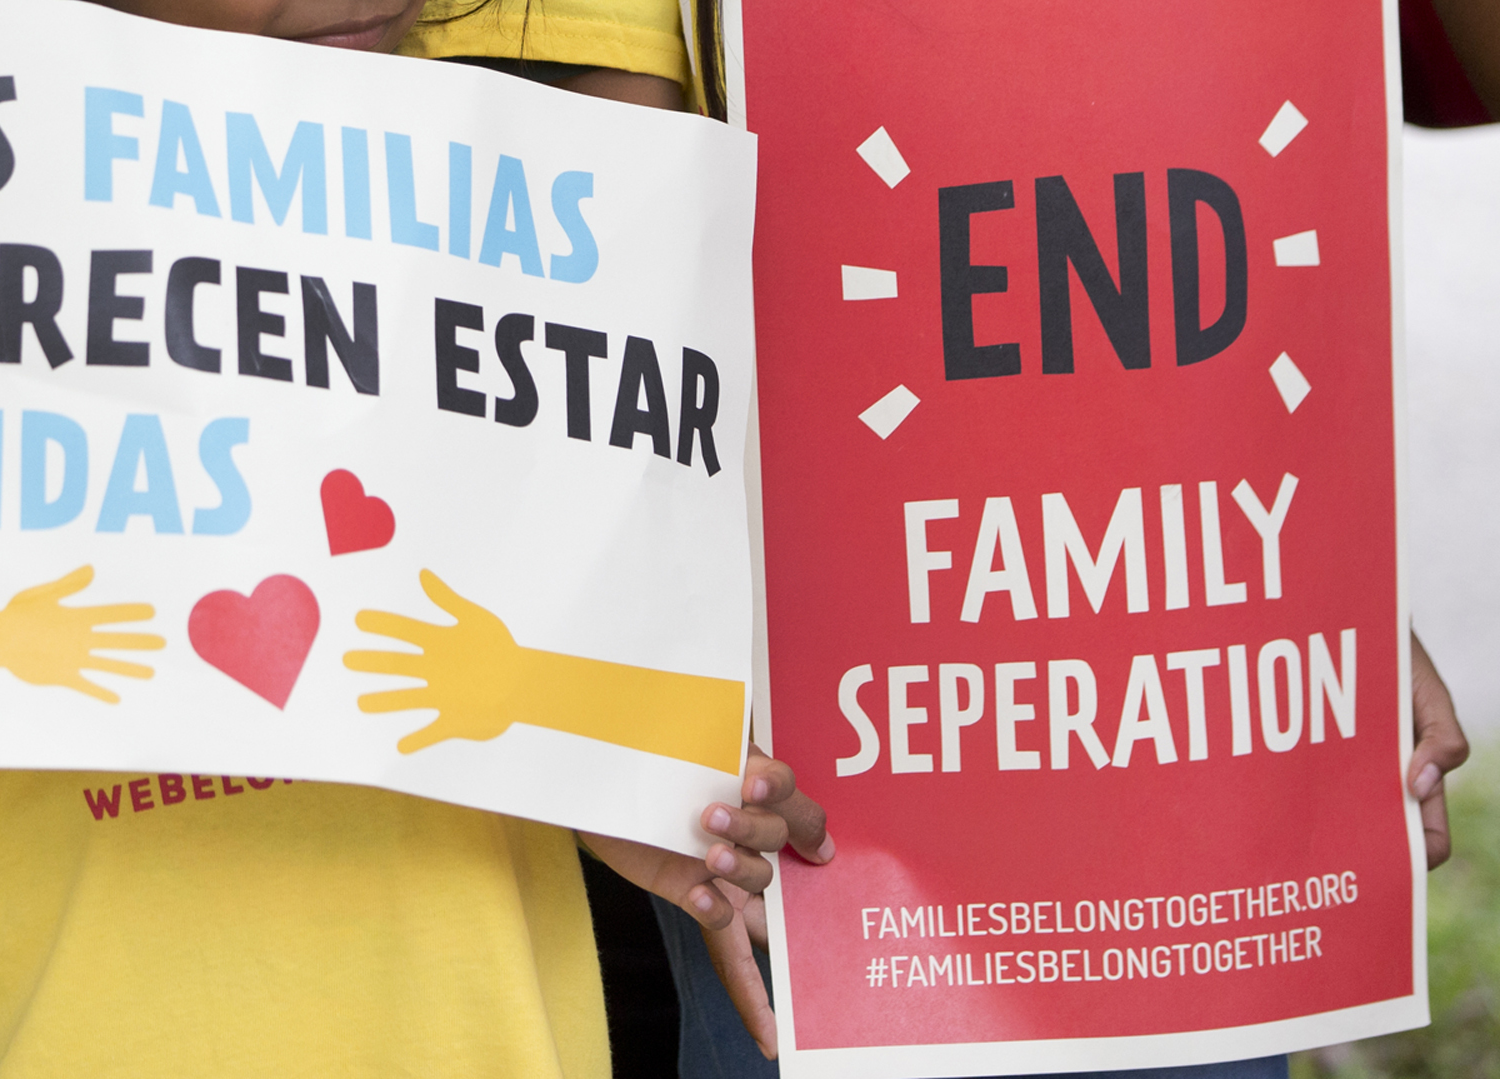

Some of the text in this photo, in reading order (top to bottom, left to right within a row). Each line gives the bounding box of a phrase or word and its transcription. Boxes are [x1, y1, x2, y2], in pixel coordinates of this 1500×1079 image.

[82, 85, 600, 284] FAMILIAS
[938, 167, 1250, 382] END
[433, 296, 722, 478] ESTAR
[902, 471, 1300, 625] FAMILY
[835, 627, 1359, 778] SEPERATION
[861, 870, 1359, 940] FAMILIESBELONGTOGETHER.ORG
[865, 925, 1323, 989] #FAMILIESBELONGTOGETHER
